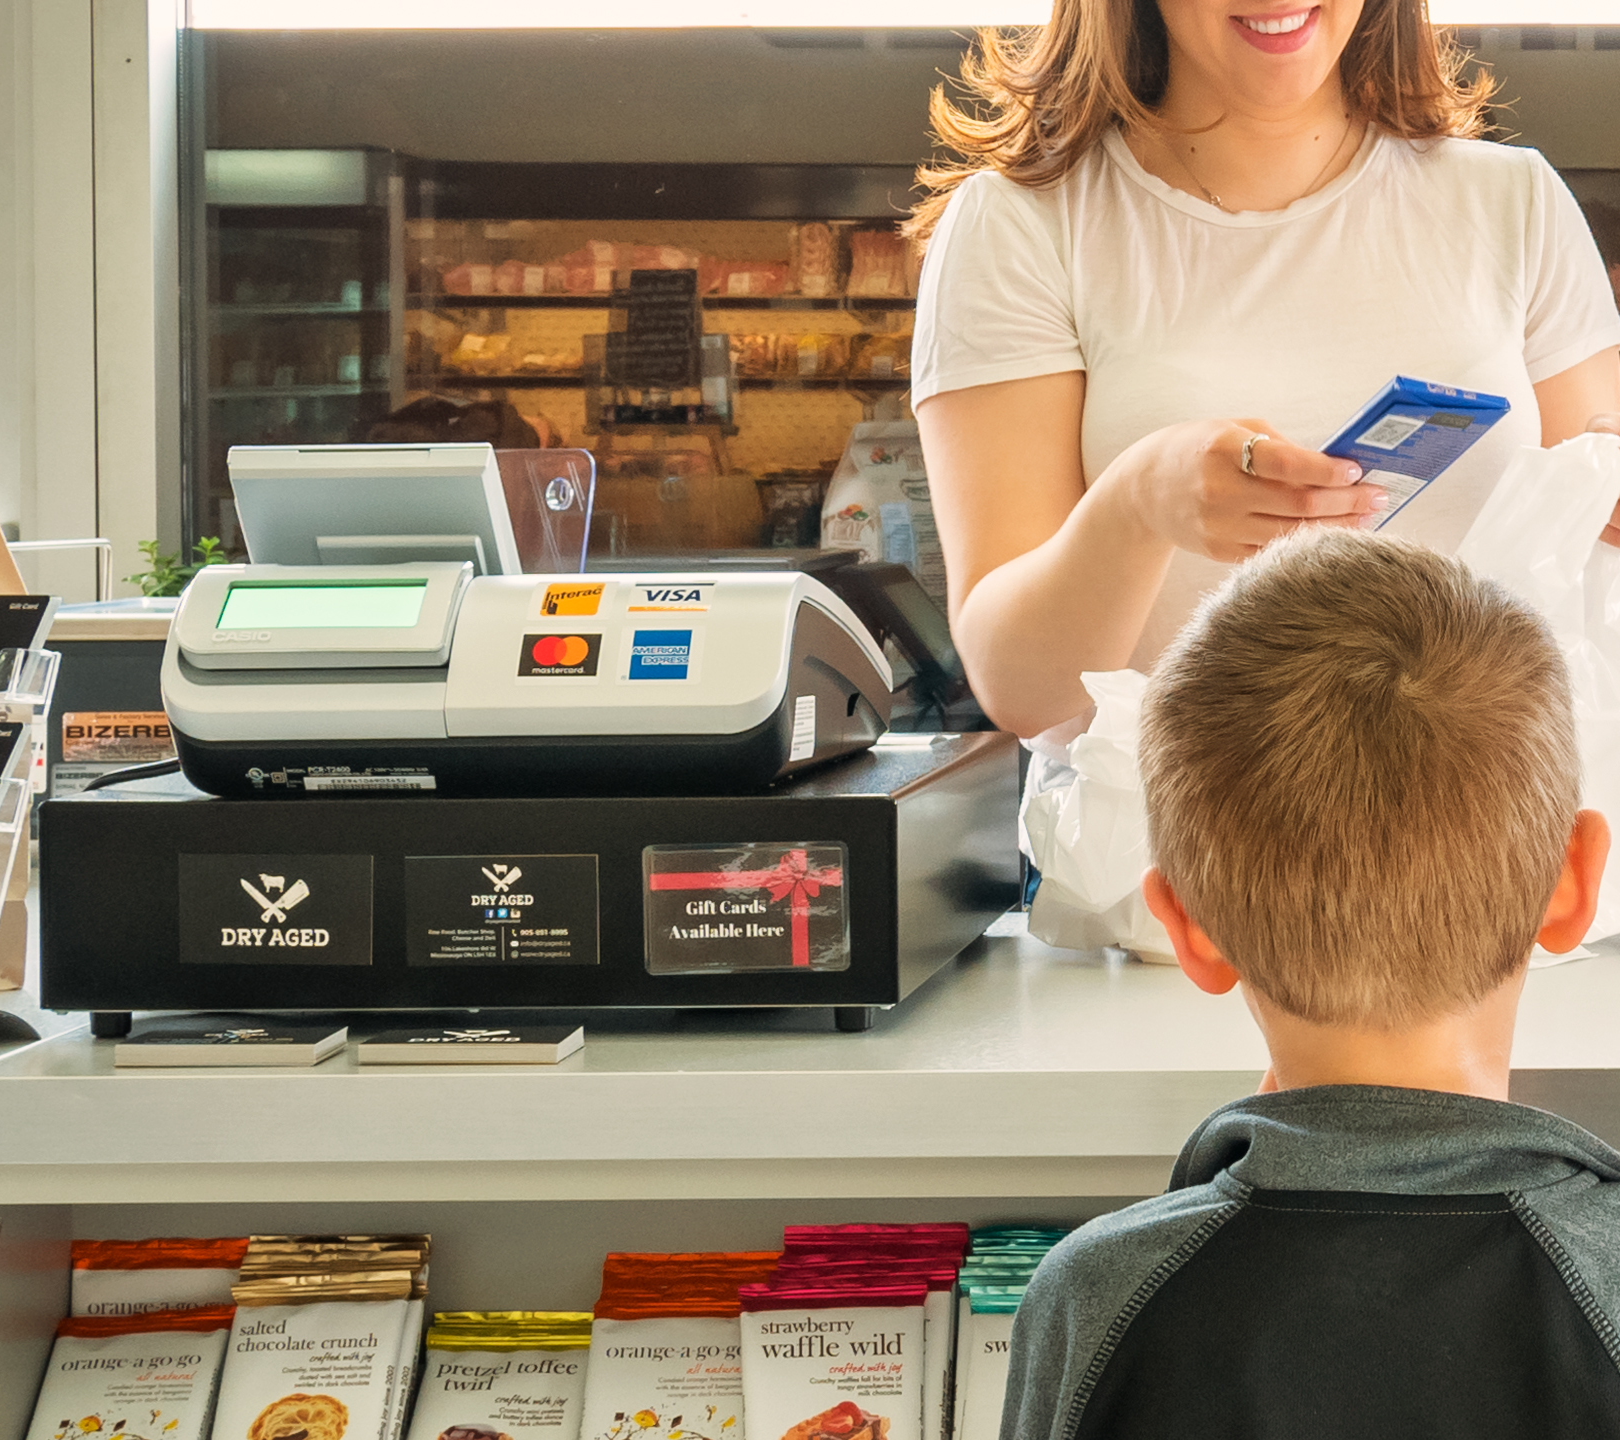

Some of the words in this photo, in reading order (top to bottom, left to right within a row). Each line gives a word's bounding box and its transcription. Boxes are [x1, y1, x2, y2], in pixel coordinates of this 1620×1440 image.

[543, 585, 603, 605] Interac
[642, 590, 702, 602] VISA
[212, 630, 271, 644] CASIO
[632, 647, 689, 655] AMERICAN
[642, 656, 689, 665] EXPRESS
[471, 894, 496, 906] DRY
[496, 894, 534, 906] AGED
[685, 900, 719, 916] Gift
[723, 900, 766, 916] Cards
[221, 928, 266, 948] DRY
[267, 928, 330, 948] AGED
[670, 922, 742, 941] Available
[746, 922, 784, 939] Here
[239, 1319, 286, 1336] salted
[761, 1319, 855, 1336] strawberry
[237, 1336, 315, 1353] chocolate
[321, 1333, 378, 1348] crunch
[762, 1334, 841, 1358] waffle
[849, 1334, 903, 1356] wild
[309, 1353, 344, 1363] crafted
[345, 1353, 360, 1362] with
[362, 1353, 374, 1364] joy
[436, 1360, 511, 1378] pretzel
[517, 1360, 578, 1376] toffee
[445, 1374, 492, 1392] twirl
